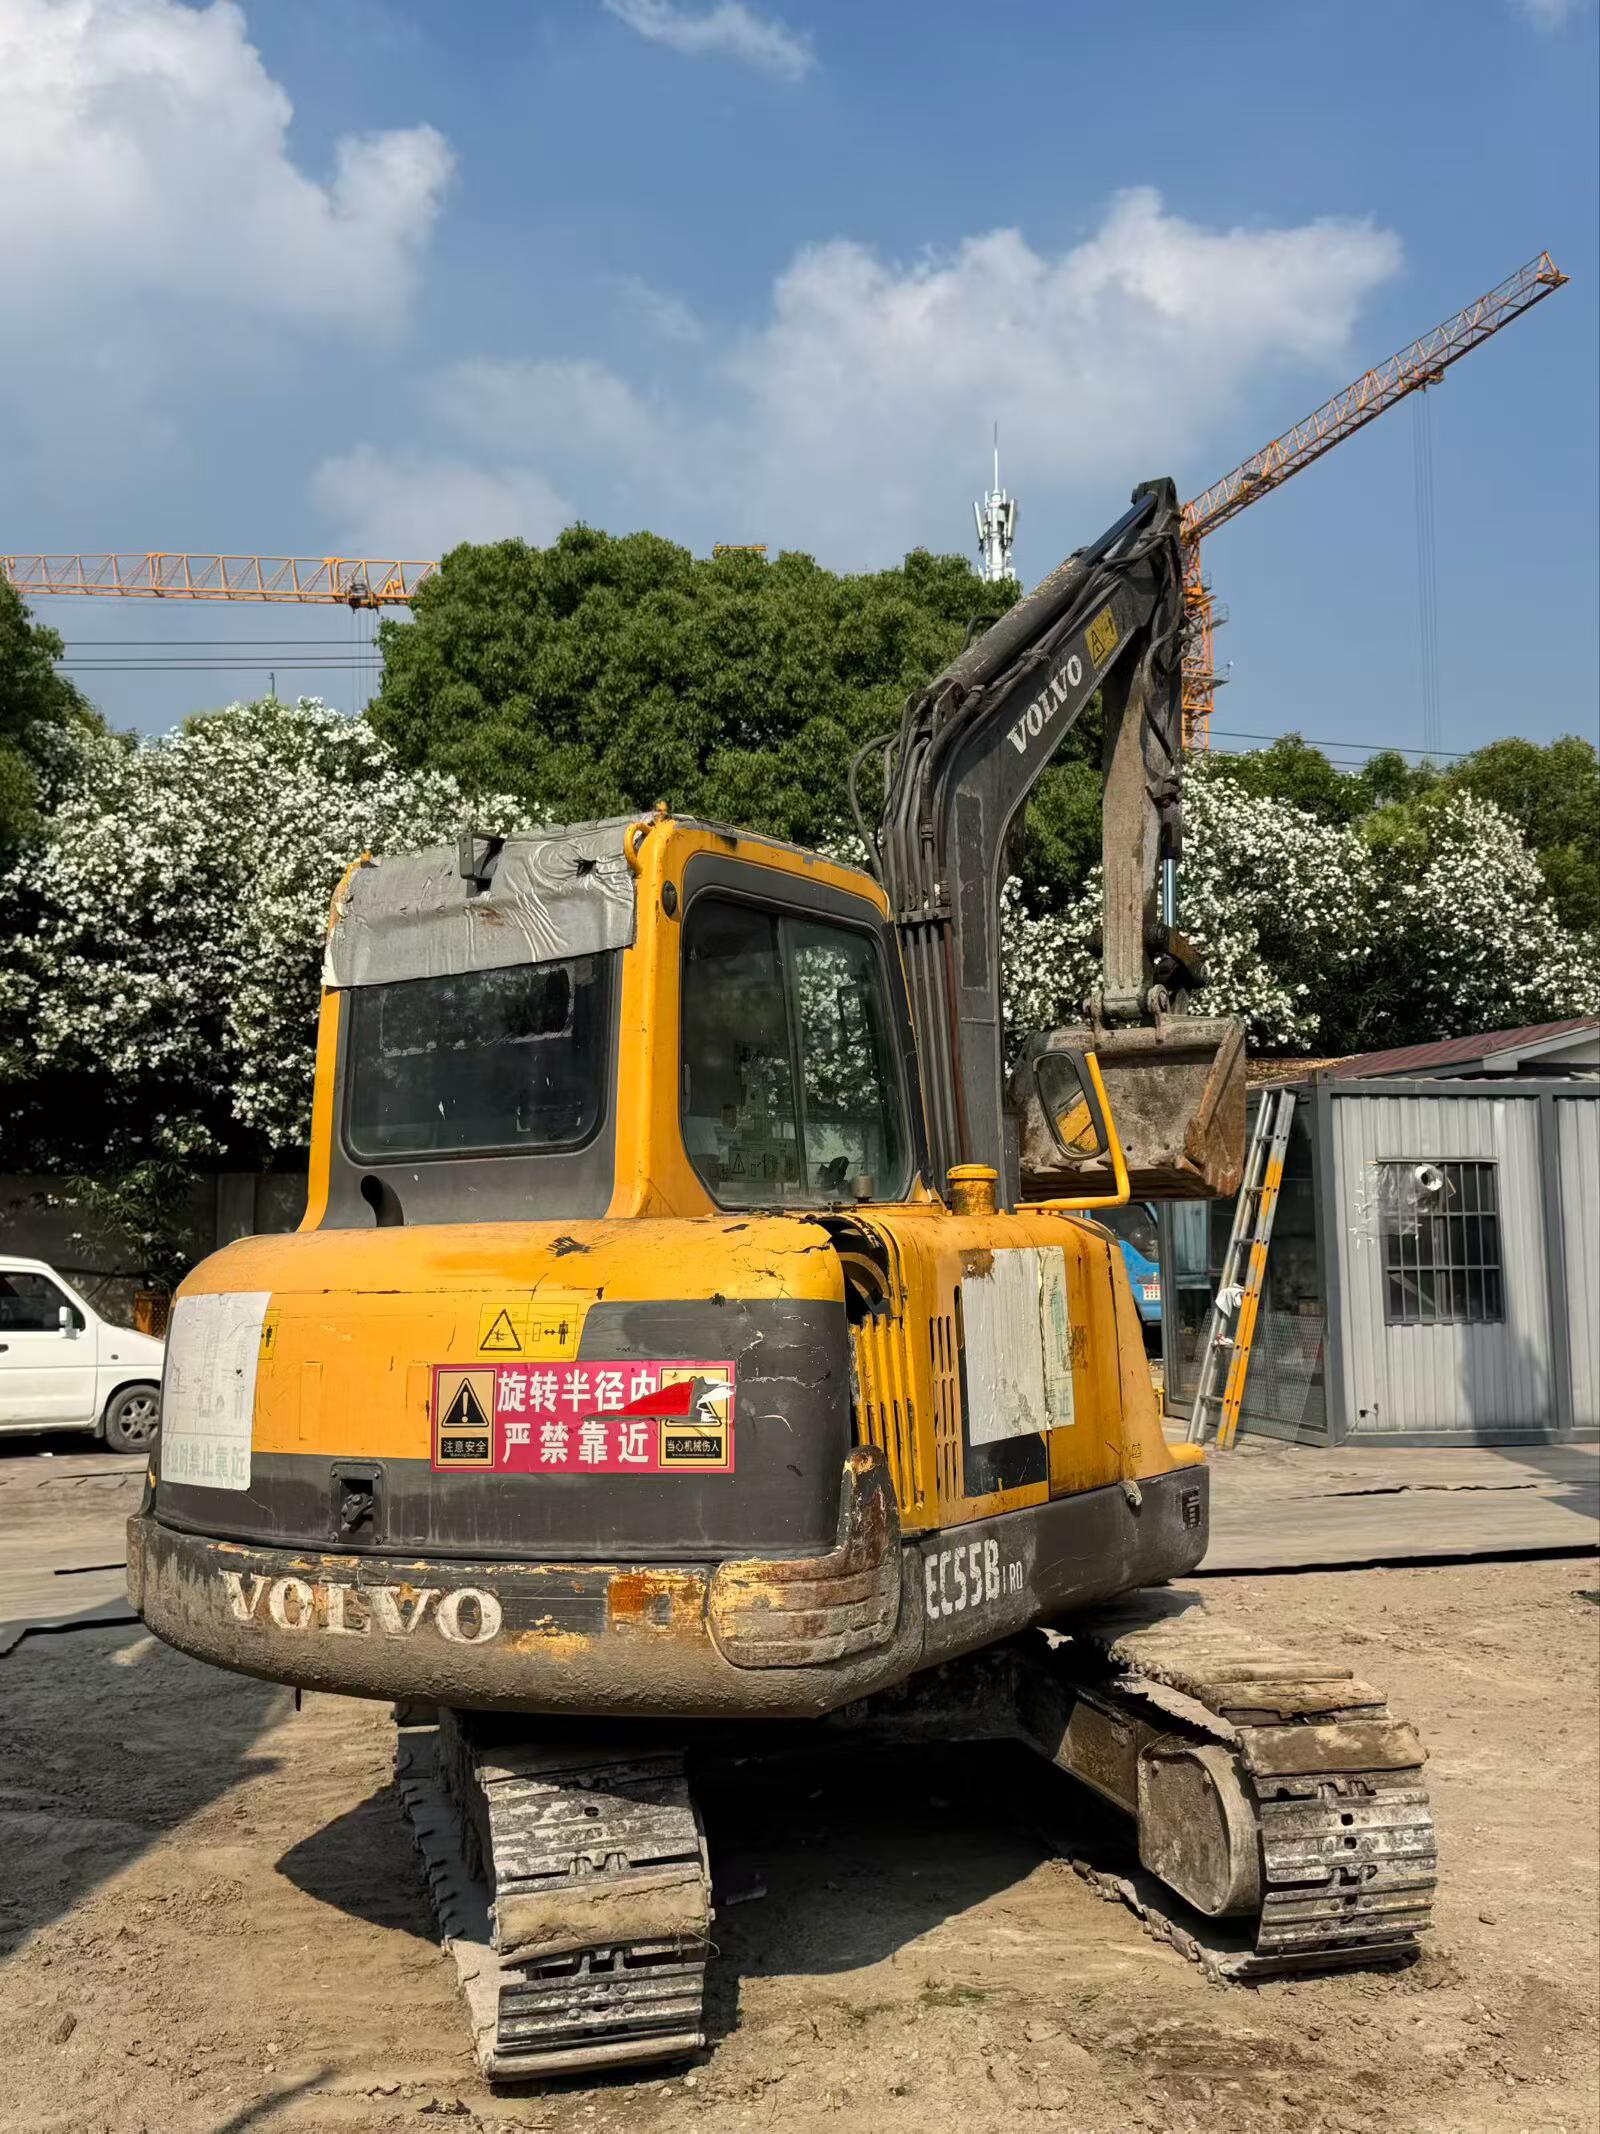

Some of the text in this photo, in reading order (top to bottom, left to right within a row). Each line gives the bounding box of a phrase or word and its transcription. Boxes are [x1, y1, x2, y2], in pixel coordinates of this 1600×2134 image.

[1006, 654, 1082, 754] VOLVO
[497, 1370, 656, 1413] 旋转半径内
[444, 1440, 486, 1453] 注意安全
[502, 1421, 649, 1464] 严禁靠近
[667, 1440, 720, 1453] 当心机械伤人
[925, 1538, 1000, 1619] EC55B
[218, 1568, 503, 1644] VOLVO
